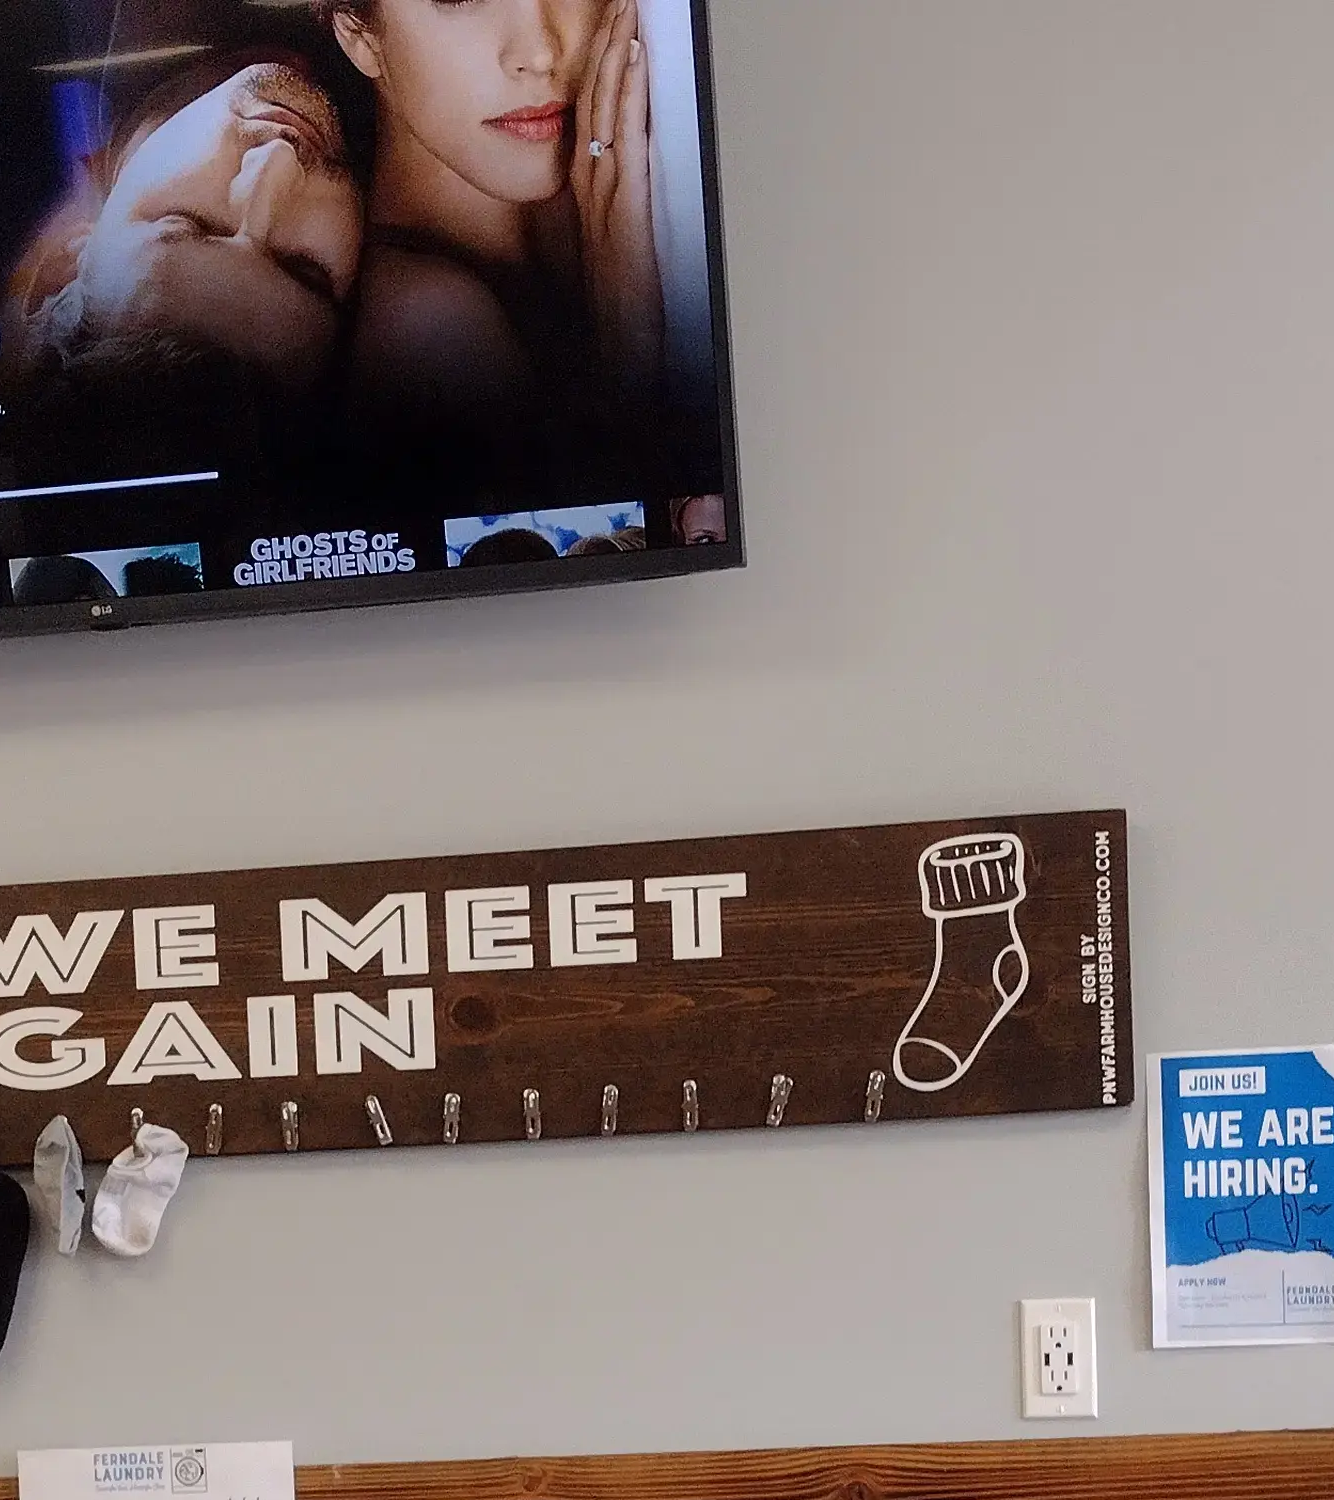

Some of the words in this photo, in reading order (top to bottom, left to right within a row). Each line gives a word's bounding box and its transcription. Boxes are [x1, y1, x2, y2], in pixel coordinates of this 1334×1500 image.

[251, 529, 366, 562] GHOSTS
[372, 533, 399, 551] OF
[233, 548, 416, 586] GIRLFRIENDS
[279, 872, 748, 982] MEET
[1080, 933, 1095, 957] BY
[1082, 963, 1097, 1005] SIGN
[1095, 830, 1117, 1106] PNWFARMHOUSEDESIGNCO.COM
[1188, 1075, 1225, 1092] JOIN
[1231, 1072, 1257, 1090] US!
[1182, 1110, 1244, 1149] WE
[1257, 1106, 1334, 1148] ARE
[1183, 1156, 1319, 1198] HIRING.
[1178, 1278, 1204, 1287] APPLY
[1207, 1277, 1226, 1287] NOW
[94, 1451, 163, 1466] FERNDALE
[94, 1467, 163, 1482] LAUNDRY
